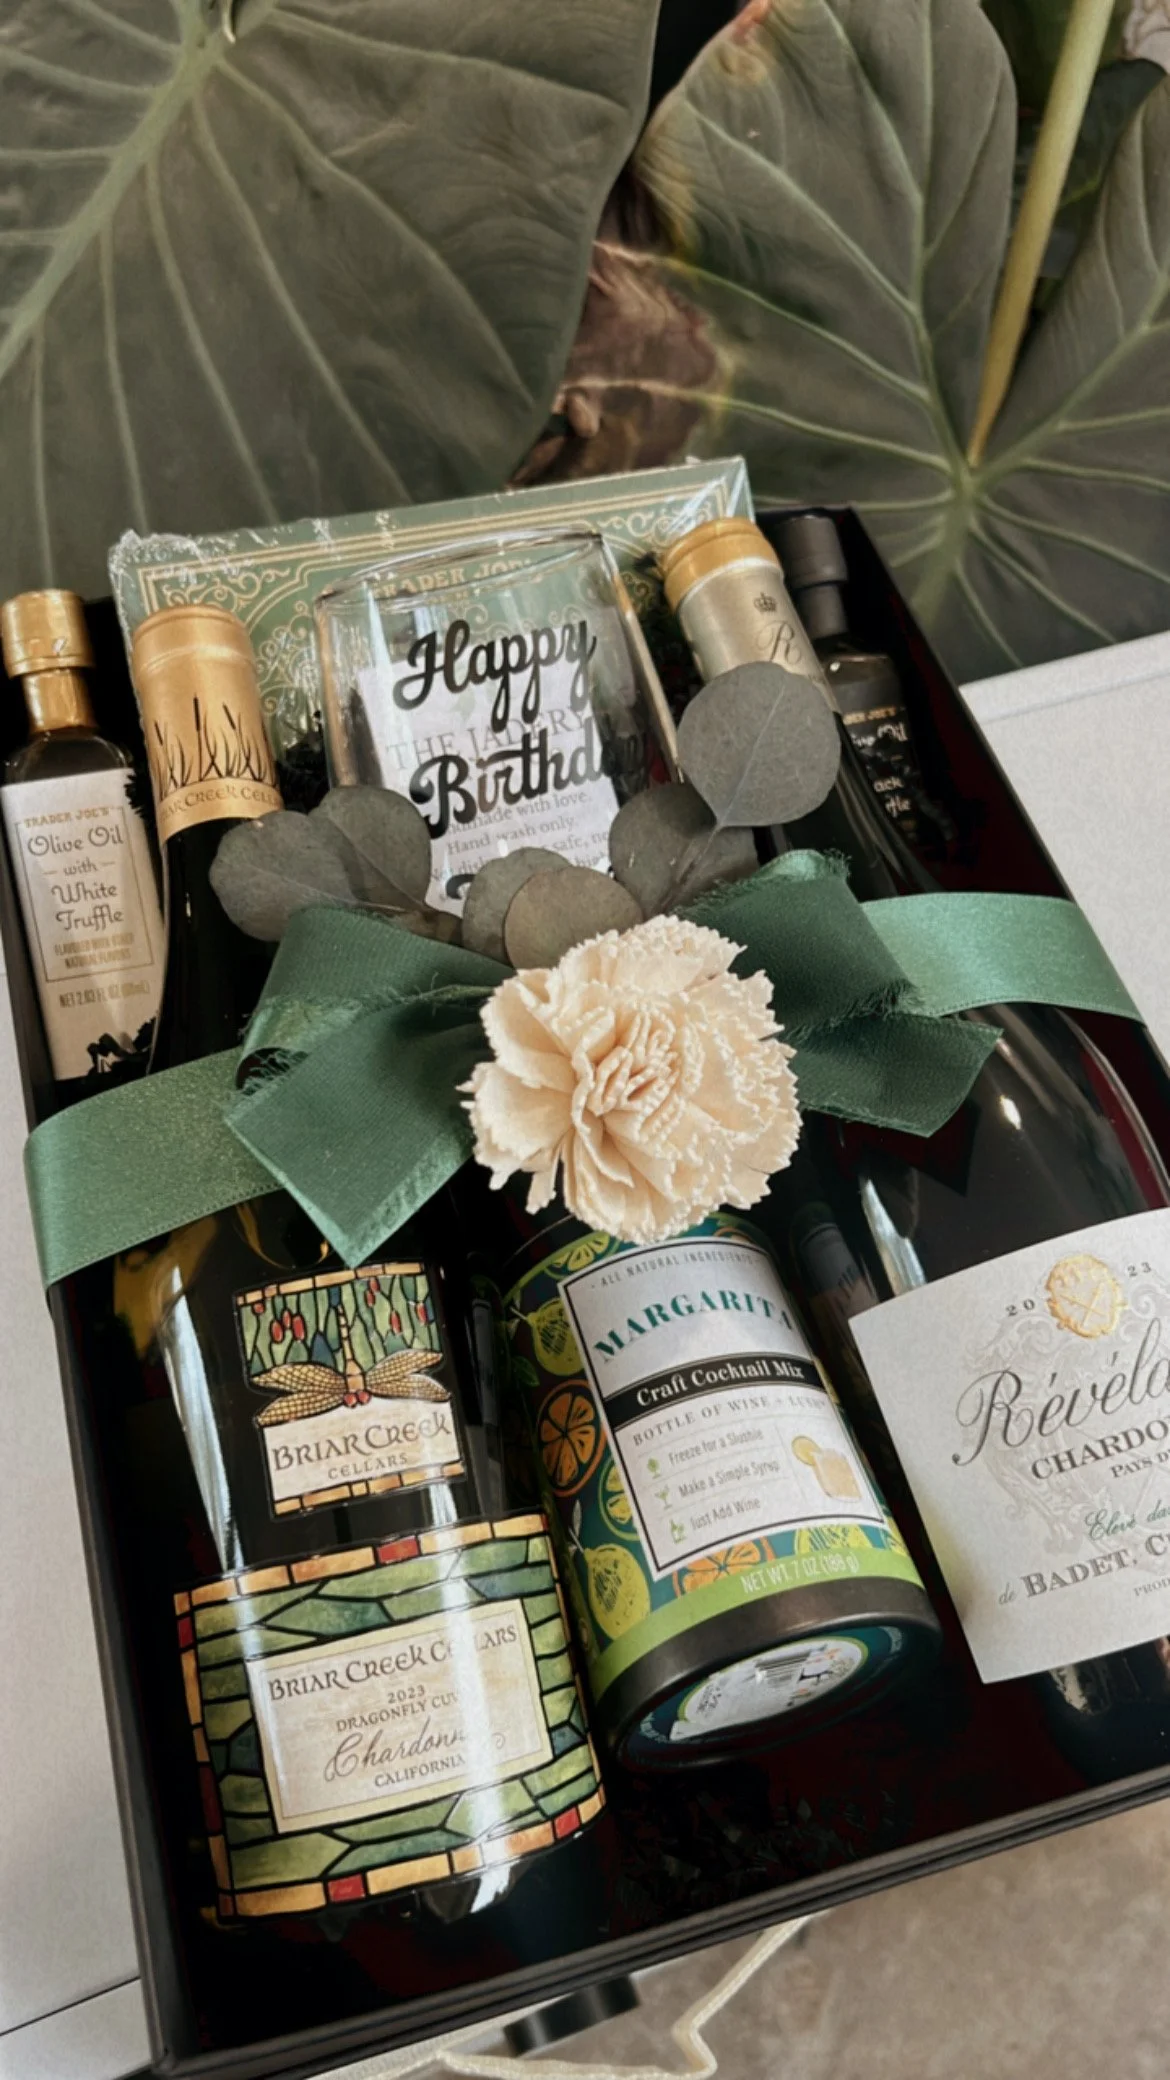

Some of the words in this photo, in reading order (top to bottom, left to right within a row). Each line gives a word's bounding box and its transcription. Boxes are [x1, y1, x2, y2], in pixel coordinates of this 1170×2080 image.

[393, 619, 597, 733] Happy
[409, 716, 603, 840] Birthd
[23, 812, 73, 829] TRADER
[516, 799, 551, 818] with
[27, 832, 84, 857] Olive
[87, 824, 124, 849] Oil
[447, 834, 491, 855] Hand
[496, 822, 537, 842] wash
[63, 857, 98, 876] with
[51, 881, 118, 905] White
[55, 904, 124, 932] Truffle
[600, 1272, 622, 1288] ALL
[626, 1254, 680, 1278] NATURAL
[593, 1288, 794, 1364] MARGARITA
[636, 1374, 688, 1407] Craft
[690, 1358, 771, 1388] Cocktail
[772, 1358, 806, 1380] Mix
[632, 1411, 697, 1447] BOTTLE
[701, 1403, 723, 1419] OF
[729, 1395, 769, 1413] WINE
[271, 1433, 365, 1472] BRIAR
[668, 1445, 702, 1466] Freeze
[701, 1439, 717, 1453] for
[719, 1437, 727, 1449] a
[1031, 1417, 1170, 1479] CHARDO
[327, 1452, 408, 1480] CELLARS
[679, 1478, 707, 1498] Make
[708, 1476, 716, 1488] a
[715, 1464, 752, 1485] Simple
[751, 1460, 780, 1477] Syrup
[1111, 1458, 1153, 1478] PAYS
[690, 1511, 712, 1531] Just
[712, 1502, 734, 1521] Add
[733, 1497, 761, 1514] Wine
[741, 1570, 767, 1594] NET
[802, 1556, 822, 1578] OZ
[998, 1582, 1016, 1605] de
[268, 1667, 350, 1701] BRIAR
[386, 1683, 427, 1705] 2023
[335, 1701, 428, 1733] DRAGONFLY
[374, 1753, 467, 1788] CALIFORNIA
